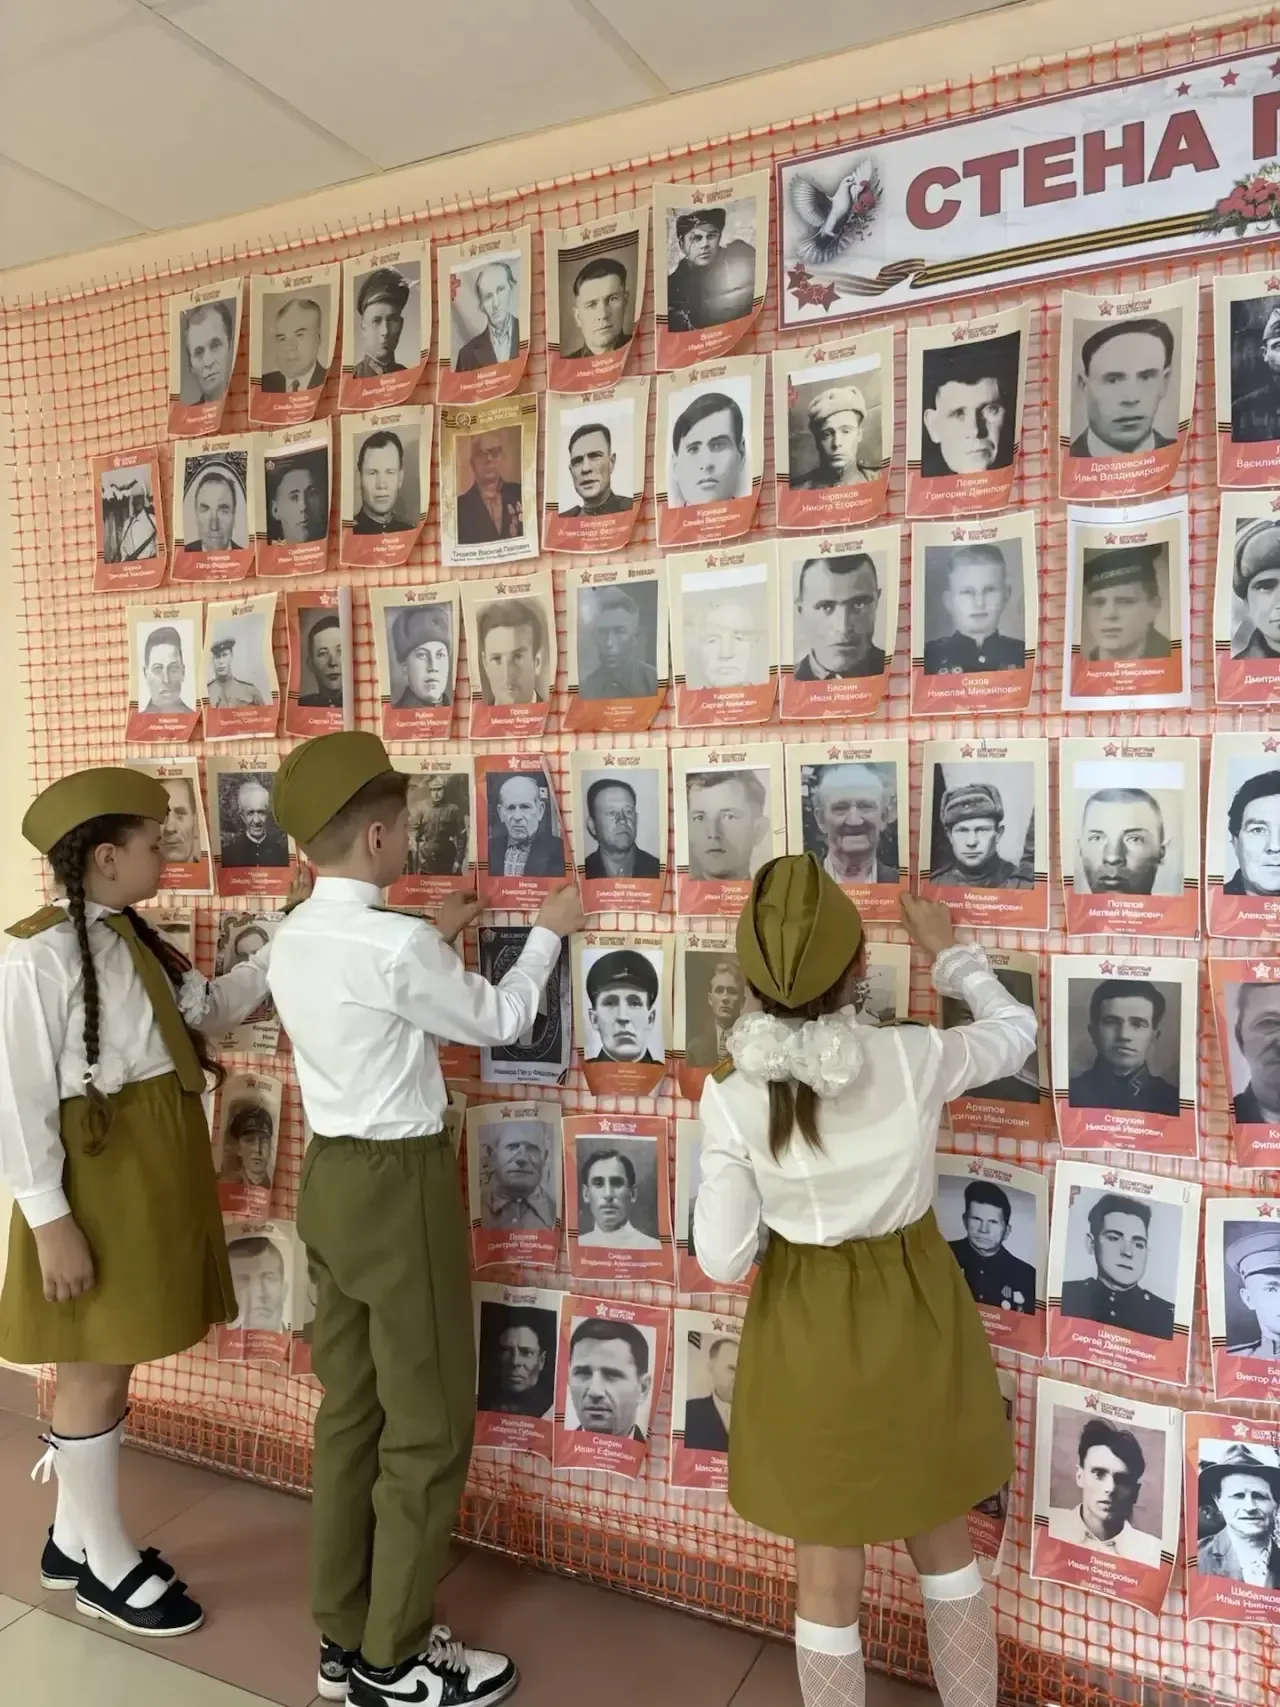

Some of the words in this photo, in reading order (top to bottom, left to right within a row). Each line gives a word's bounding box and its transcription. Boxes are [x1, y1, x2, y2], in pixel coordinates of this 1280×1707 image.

[905, 109, 1219, 230] СТЕНА
[1091, 456, 1156, 474] Дроздовский
[1074, 472, 1098, 482] Илья
[926, 490, 967, 502] Григорий
[802, 503, 834, 512] Никита
[927, 688, 965, 697] Николай
[966, 1102, 1005, 1114] Архипов
[984, 1114, 1030, 1126] Иванович
[1085, 1122, 1120, 1132] Николай
[1098, 1329, 1132, 1344] Шкурин
[1072, 1332, 1102, 1347] Сергей
[1104, 1339, 1156, 1360] Дмитриевич
[1236, 1371, 1269, 1385] Виктор
[574, 1444, 596, 1454] Иван
[1067, 1558, 1089, 1572] Иван
[1216, 1592, 1240, 1606] Илья
